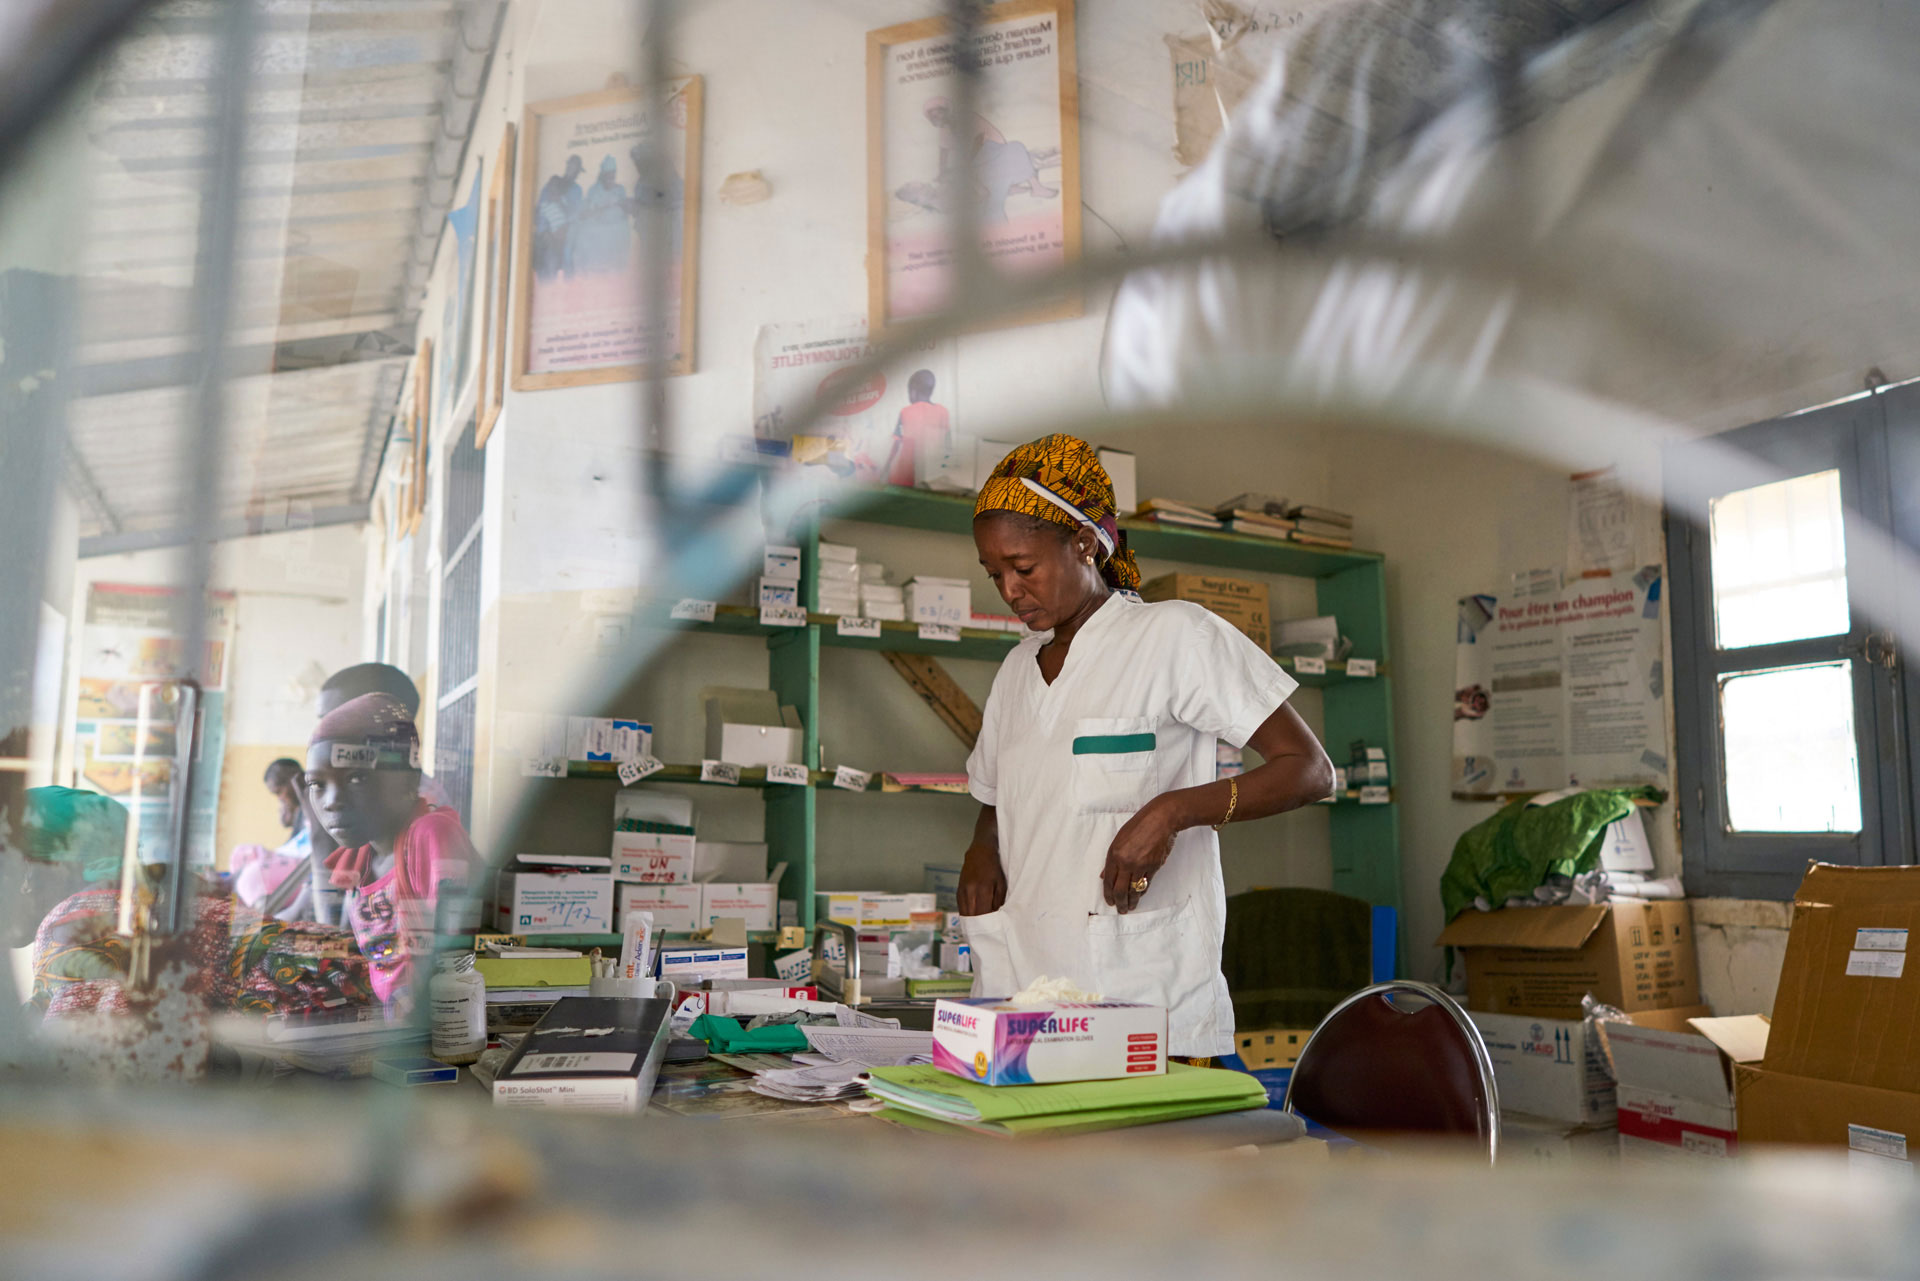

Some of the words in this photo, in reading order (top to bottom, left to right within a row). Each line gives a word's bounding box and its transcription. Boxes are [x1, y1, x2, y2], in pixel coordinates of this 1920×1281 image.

[1498, 606, 1524, 620] Pour
[1527, 601, 1550, 617] être
[1553, 600, 1570, 613] un
[1572, 588, 1634, 609] champion
[634, 928, 646, 961] Adenuric
[1521, 1040, 1554, 1055] USAID
[978, 1056, 985, 1067] M
[507, 1086, 519, 1094] BD
[559, 1086, 576, 1094] Mini
